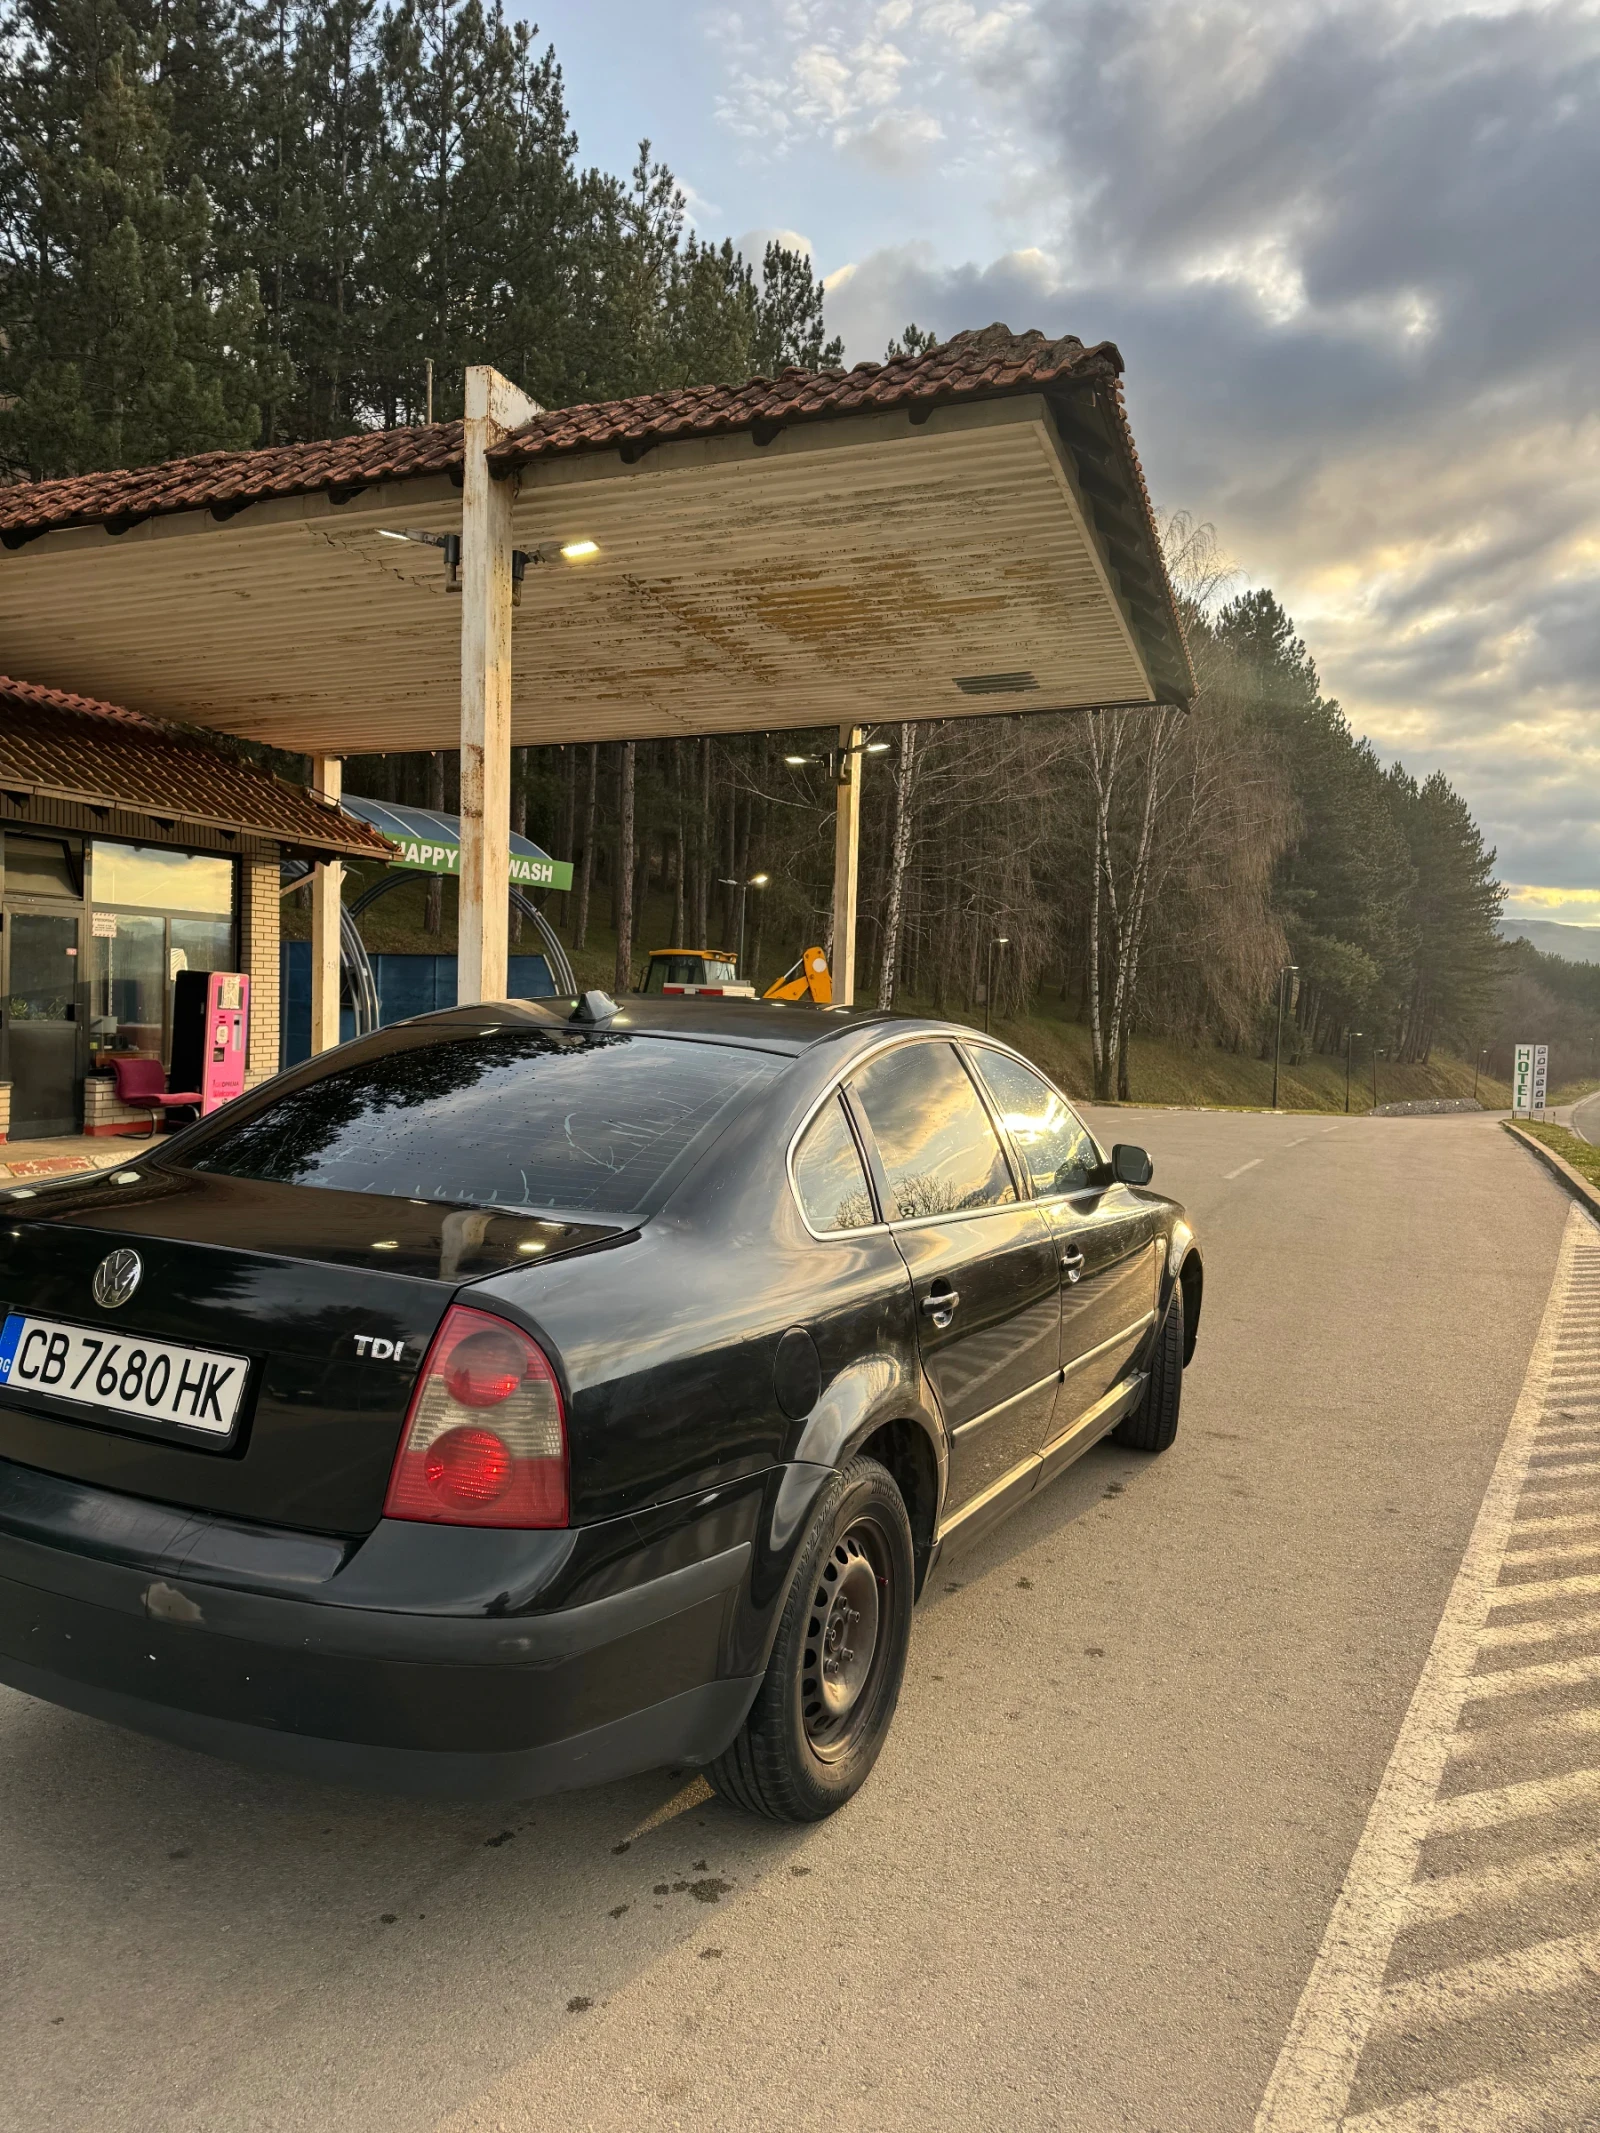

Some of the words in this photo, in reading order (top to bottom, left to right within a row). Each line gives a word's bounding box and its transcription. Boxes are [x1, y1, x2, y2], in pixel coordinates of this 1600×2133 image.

[1517, 1049, 1530, 1108] HOTEL
[18, 1329, 70, 1384] CB
[70, 1338, 171, 1406] 7680
[172, 1358, 236, 1421] HK
[353, 1334, 405, 1361] TDI
